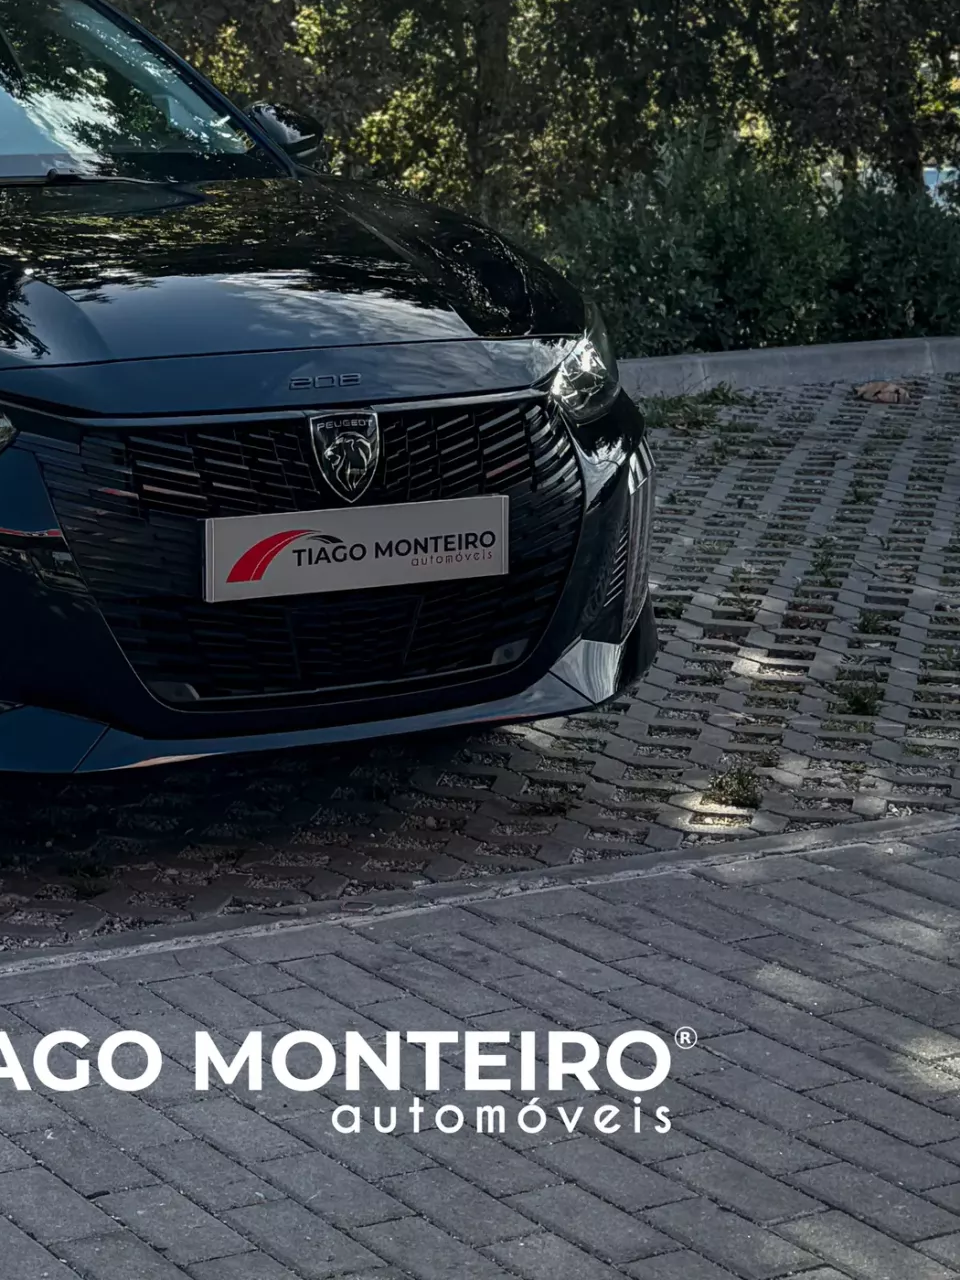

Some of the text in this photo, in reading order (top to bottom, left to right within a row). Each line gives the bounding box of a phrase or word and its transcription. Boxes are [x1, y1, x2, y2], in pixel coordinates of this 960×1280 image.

[289, 373, 362, 390] 208
[317, 419, 374, 431] PEUGEOT
[292, 531, 496, 567] TIAGO MONTEIRO
[411, 551, 493, 567] automóveis
